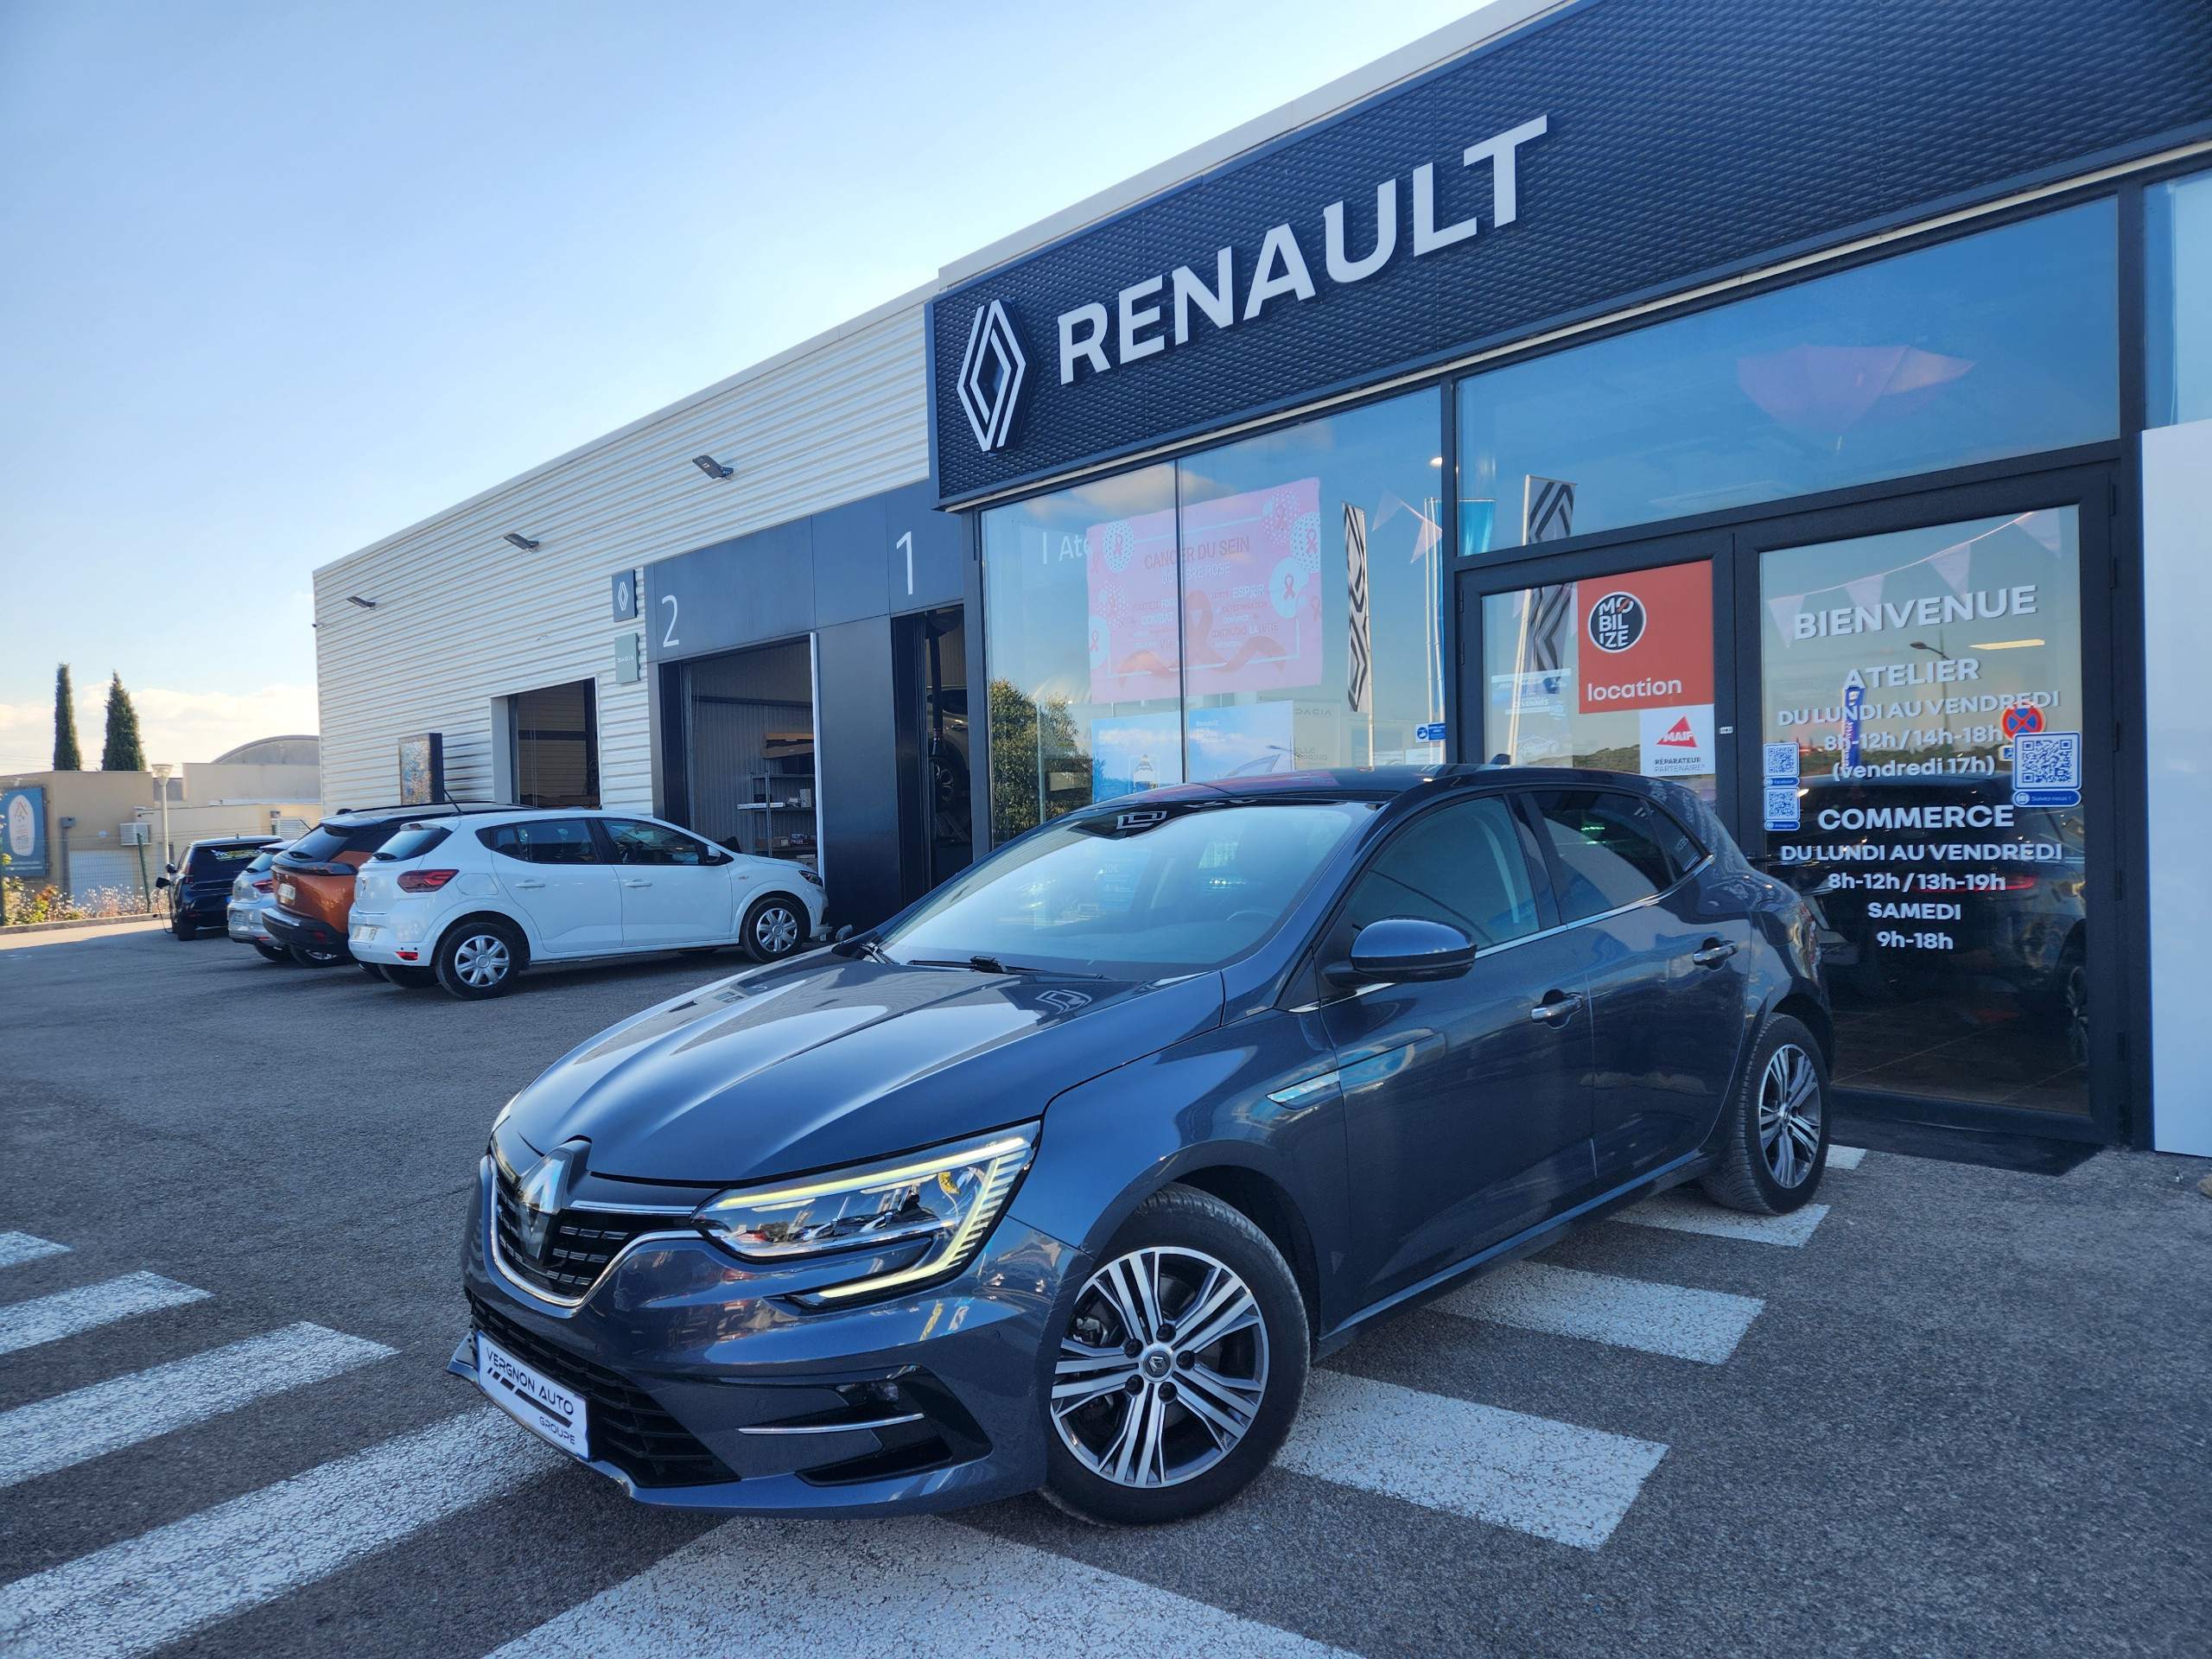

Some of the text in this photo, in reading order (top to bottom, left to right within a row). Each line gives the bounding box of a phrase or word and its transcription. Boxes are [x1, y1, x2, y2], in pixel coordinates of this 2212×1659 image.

[1058, 115, 1548, 385] RENAULT
[896, 531, 913, 595] 1
[1144, 536, 1250, 570] CANCER DU SEIN
[1161, 562, 1230, 584] OCTBRE ROSE
[661, 594, 679, 648] 2
[1141, 612, 1174, 626] COMBAT
[1795, 585, 2037, 640] BIENVENUE
[1842, 658, 1981, 690] ATELIER
[1587, 677, 1682, 702] location
[1778, 690, 2060, 727] DU LUNDI AU VENDREDI
[1662, 731, 1694, 741] MAIF
[1833, 755, 1996, 782] (vendredi 17h)
[1817, 804, 2015, 830] COMMERCE
[1781, 842, 2063, 861] DU LUNDI AU VENDREDI
[1867, 901, 1961, 921] SAMEDI
[1876, 930, 1954, 950] 9h-18h
[486, 1346, 574, 1415] VERGNON AUTO
[539, 1415, 575, 1446] GROUPE
